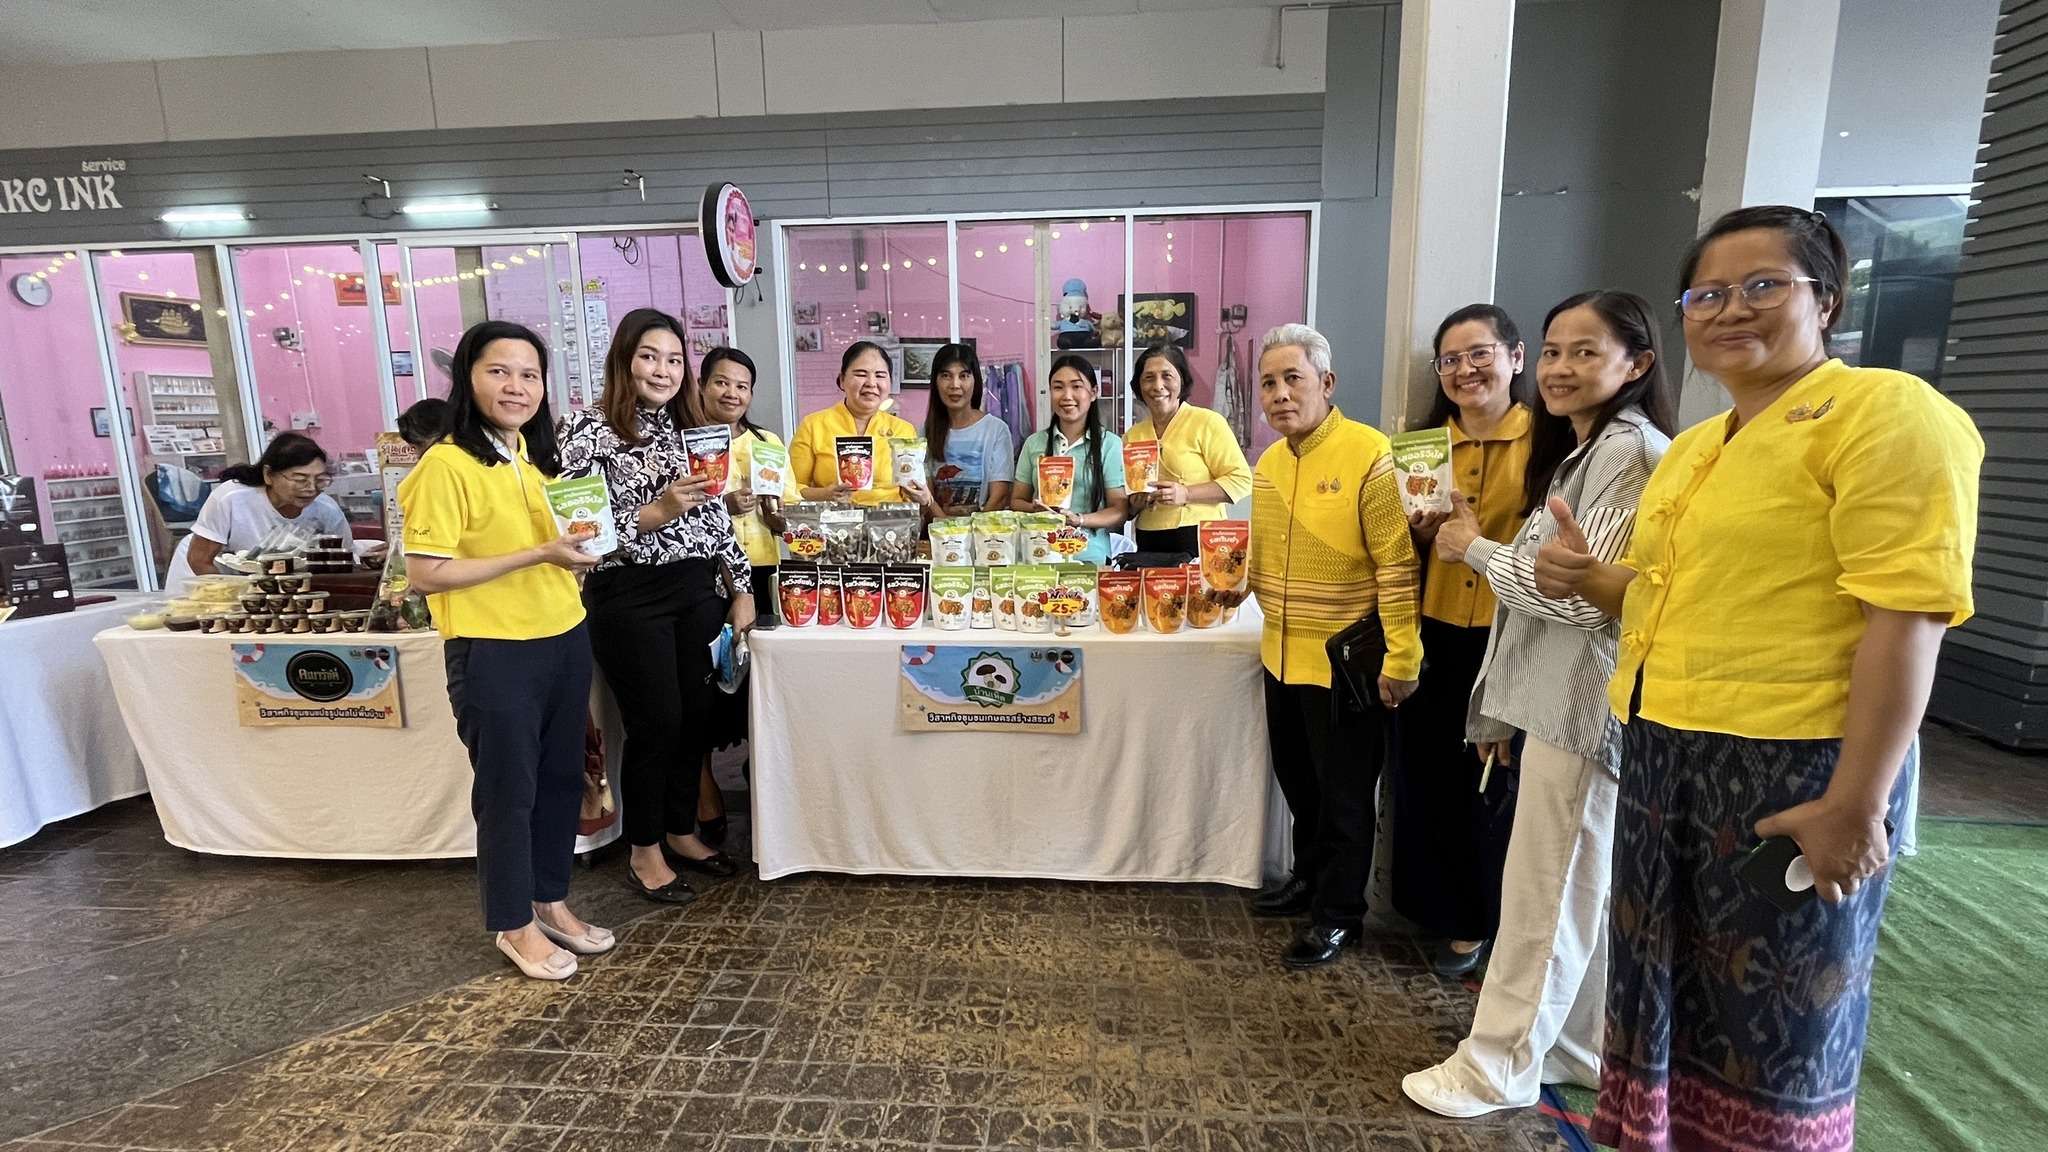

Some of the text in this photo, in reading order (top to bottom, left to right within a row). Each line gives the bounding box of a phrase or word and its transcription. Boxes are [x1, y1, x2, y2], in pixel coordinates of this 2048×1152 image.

[82, 158, 126, 172] service
[0, 174, 123, 213] KC INK
[928, 713, 1054, 725] วิสาหกิจชุมชนเกษตรสร้างสรรค์
